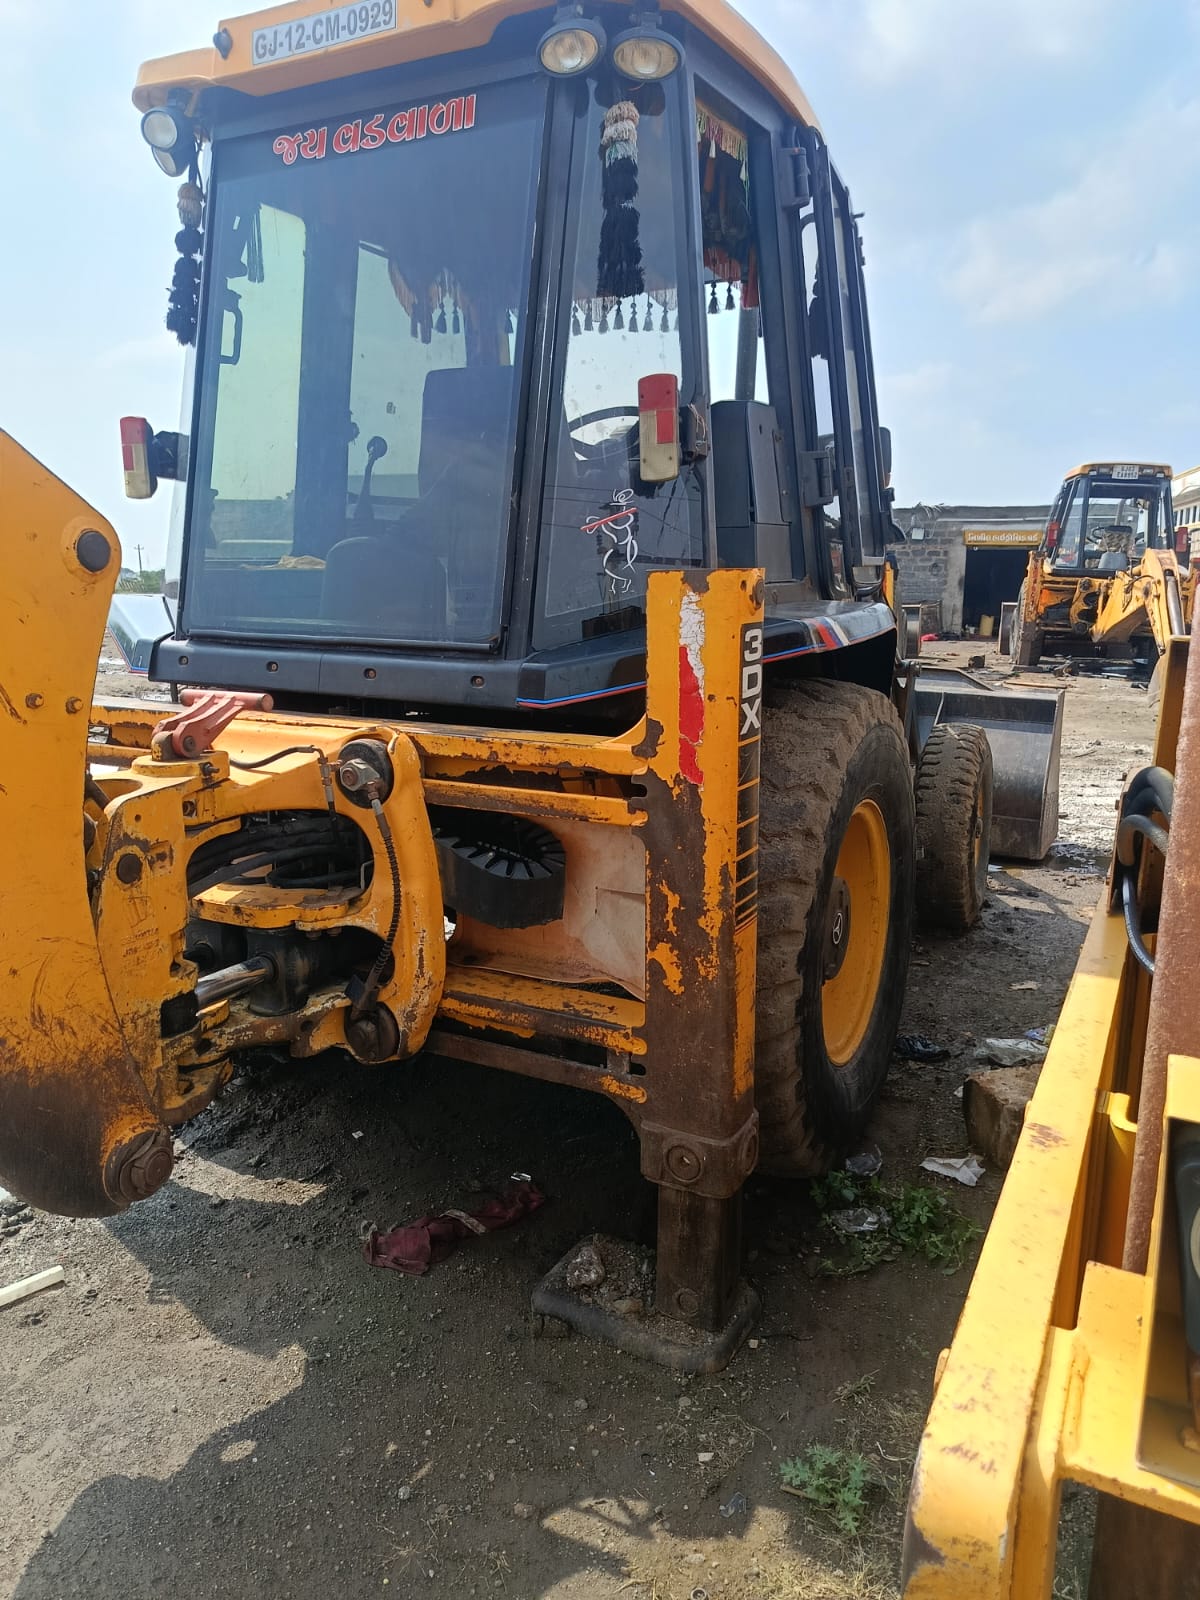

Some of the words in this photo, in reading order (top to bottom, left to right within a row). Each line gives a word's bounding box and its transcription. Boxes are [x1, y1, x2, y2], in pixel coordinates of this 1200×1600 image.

[254, 0, 394, 59] GJ-12-CM-0929
[272, 126, 327, 165] જય
[332, 94, 477, 154] વડવાળા
[740, 628, 762, 736] 3DX
